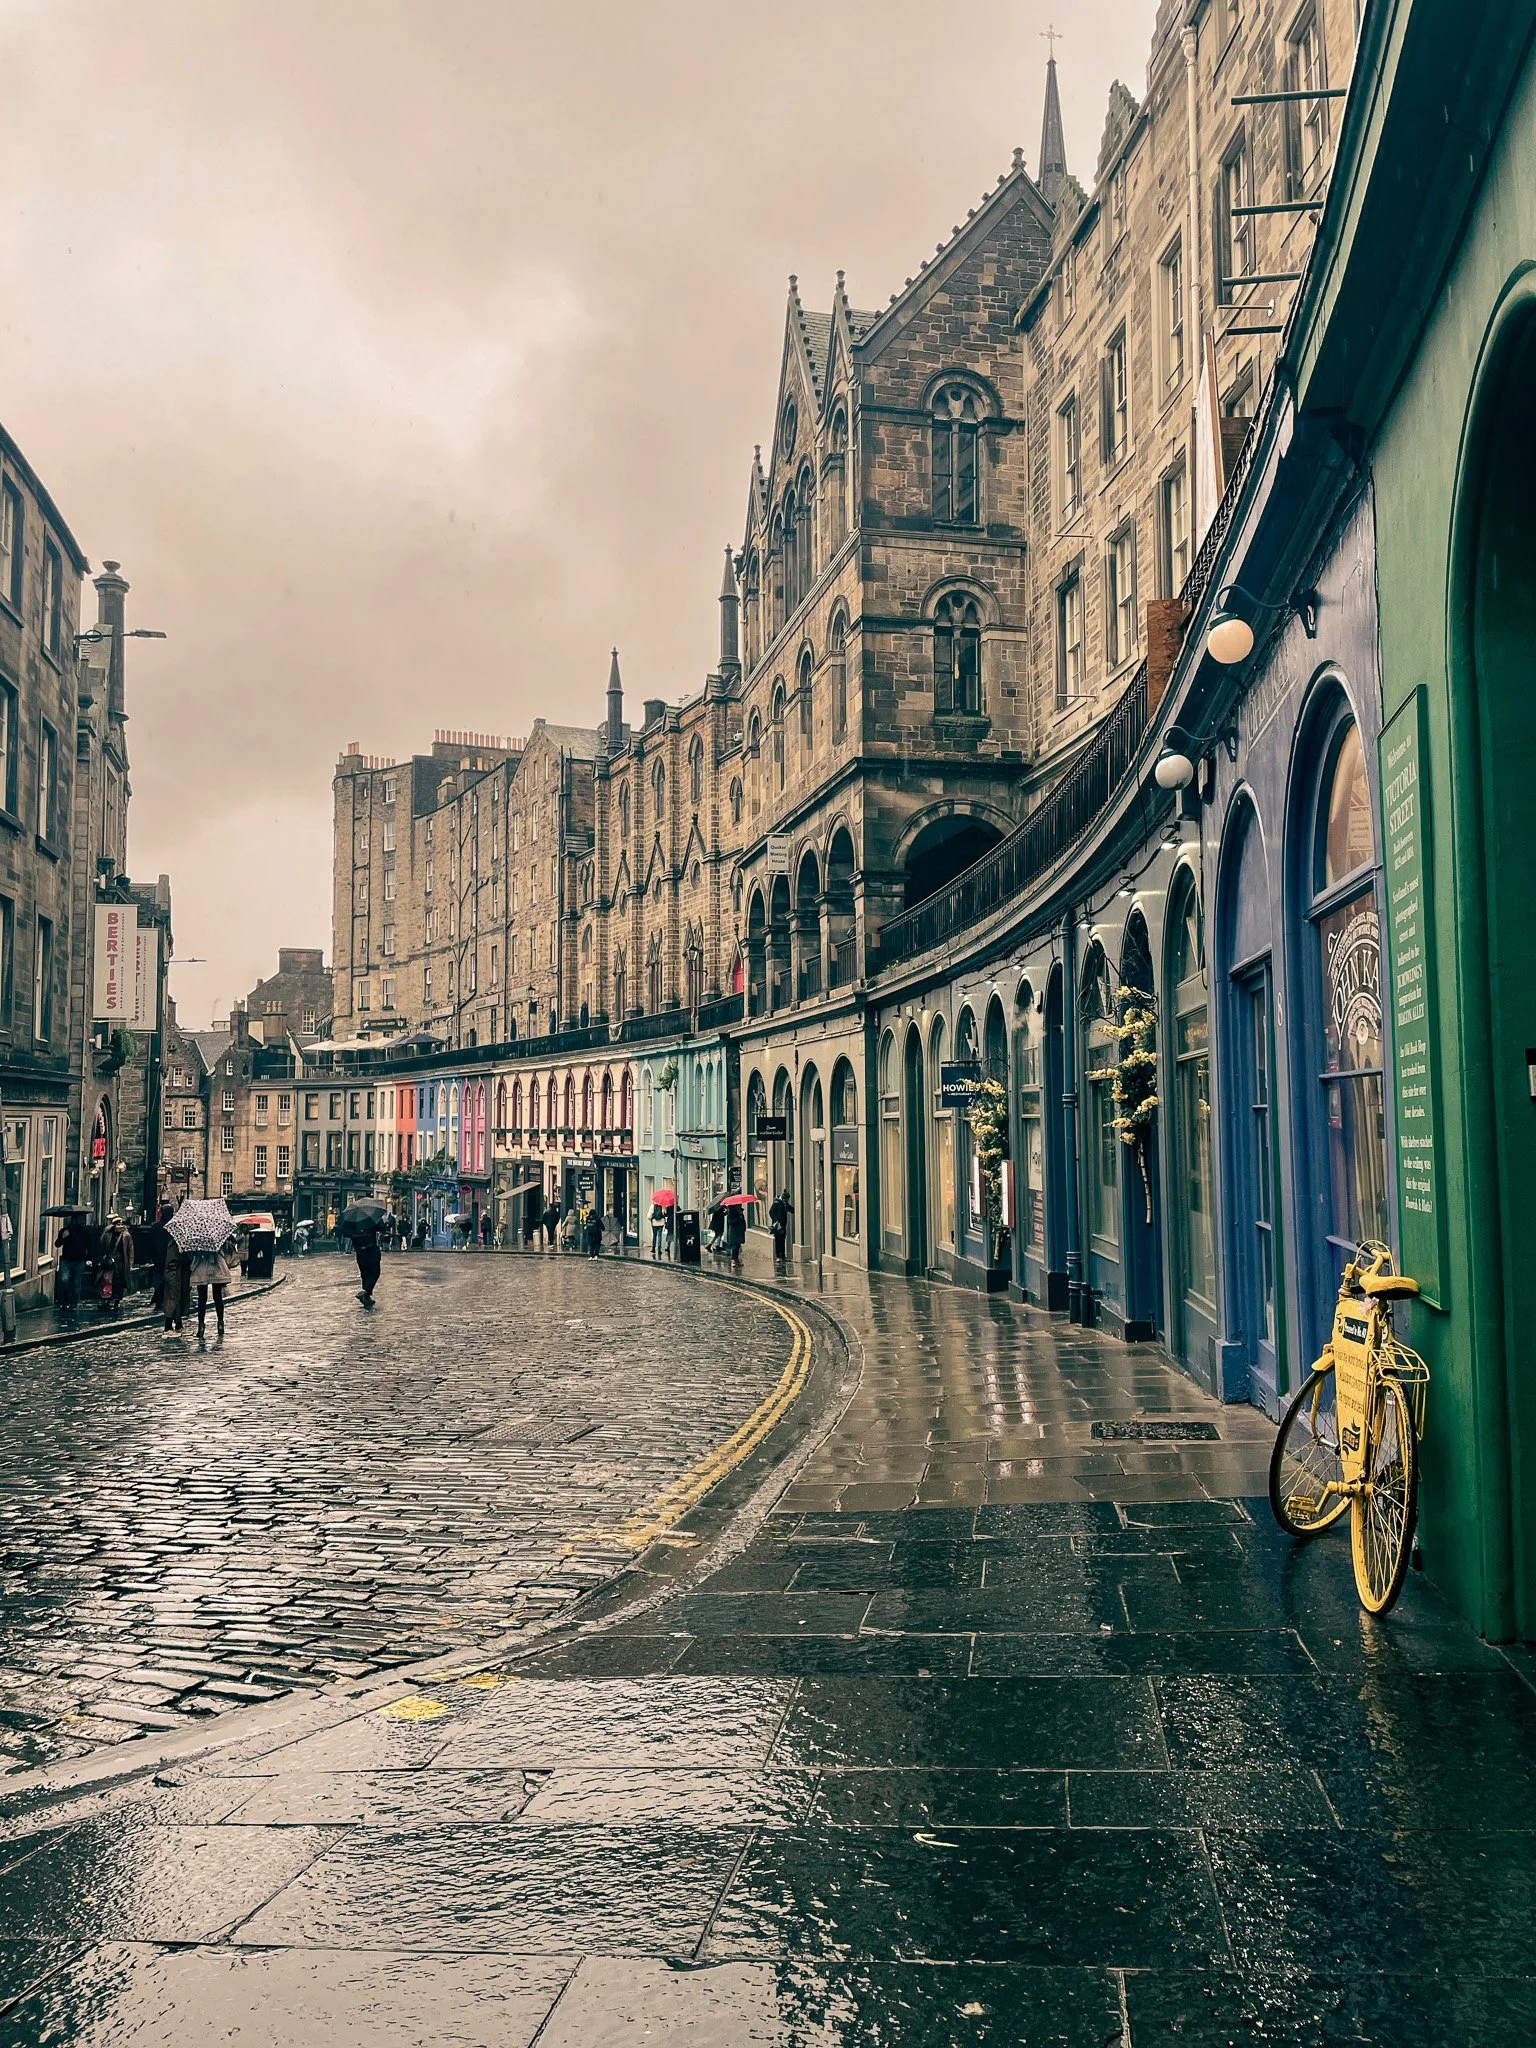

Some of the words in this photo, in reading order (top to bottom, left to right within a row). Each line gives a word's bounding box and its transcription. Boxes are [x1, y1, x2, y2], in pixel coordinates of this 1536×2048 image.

[1385, 758, 1416, 809] VICTORIA
[1390, 792, 1414, 836] STREET
[106, 912, 118, 1010] BERTIES
[1277, 992, 1284, 1027] 8
[1332, 950, 1360, 1050] JOHN
[1362, 949, 1381, 1003] KA
